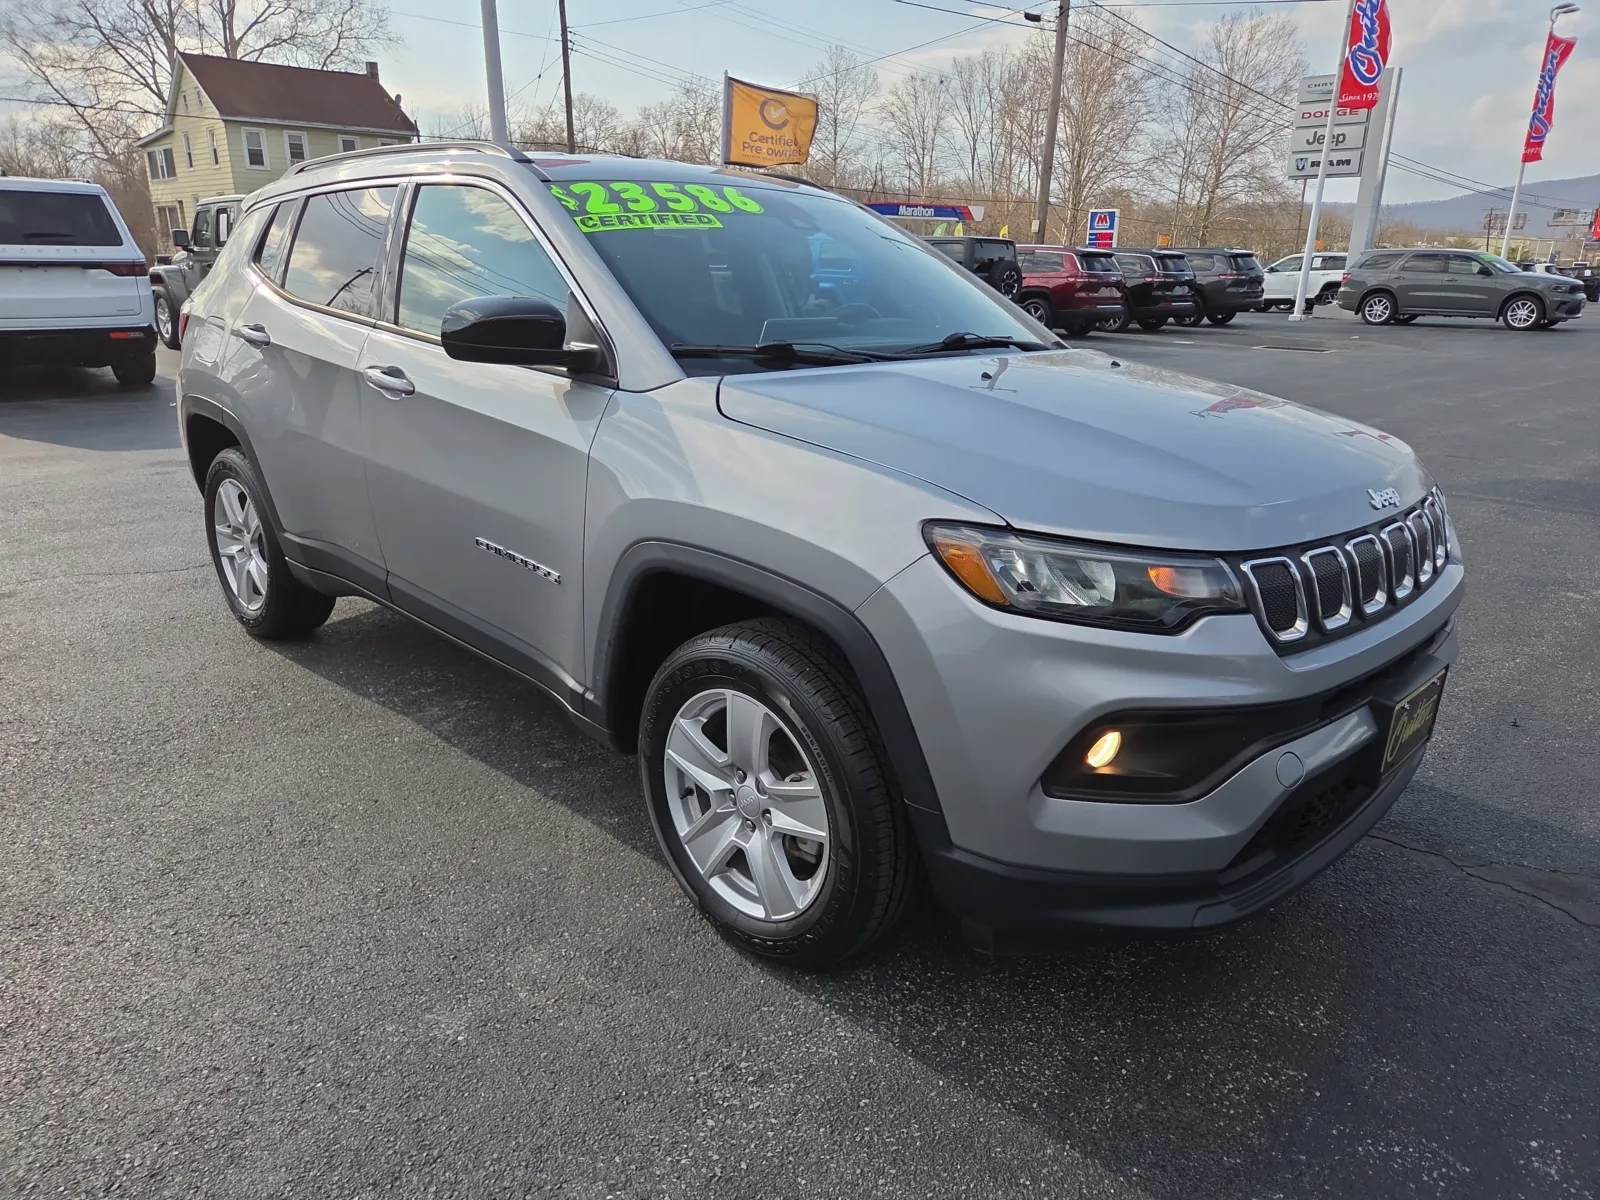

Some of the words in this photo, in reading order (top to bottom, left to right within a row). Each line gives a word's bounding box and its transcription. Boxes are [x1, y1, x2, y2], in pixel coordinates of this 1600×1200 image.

[1361, 92, 1378, 101] 197
[550, 182, 765, 215] $23586
[898, 205, 935, 217] Marathon
[579, 213, 716, 229] CERTIFIED
[1366, 487, 1401, 511] Jeep
